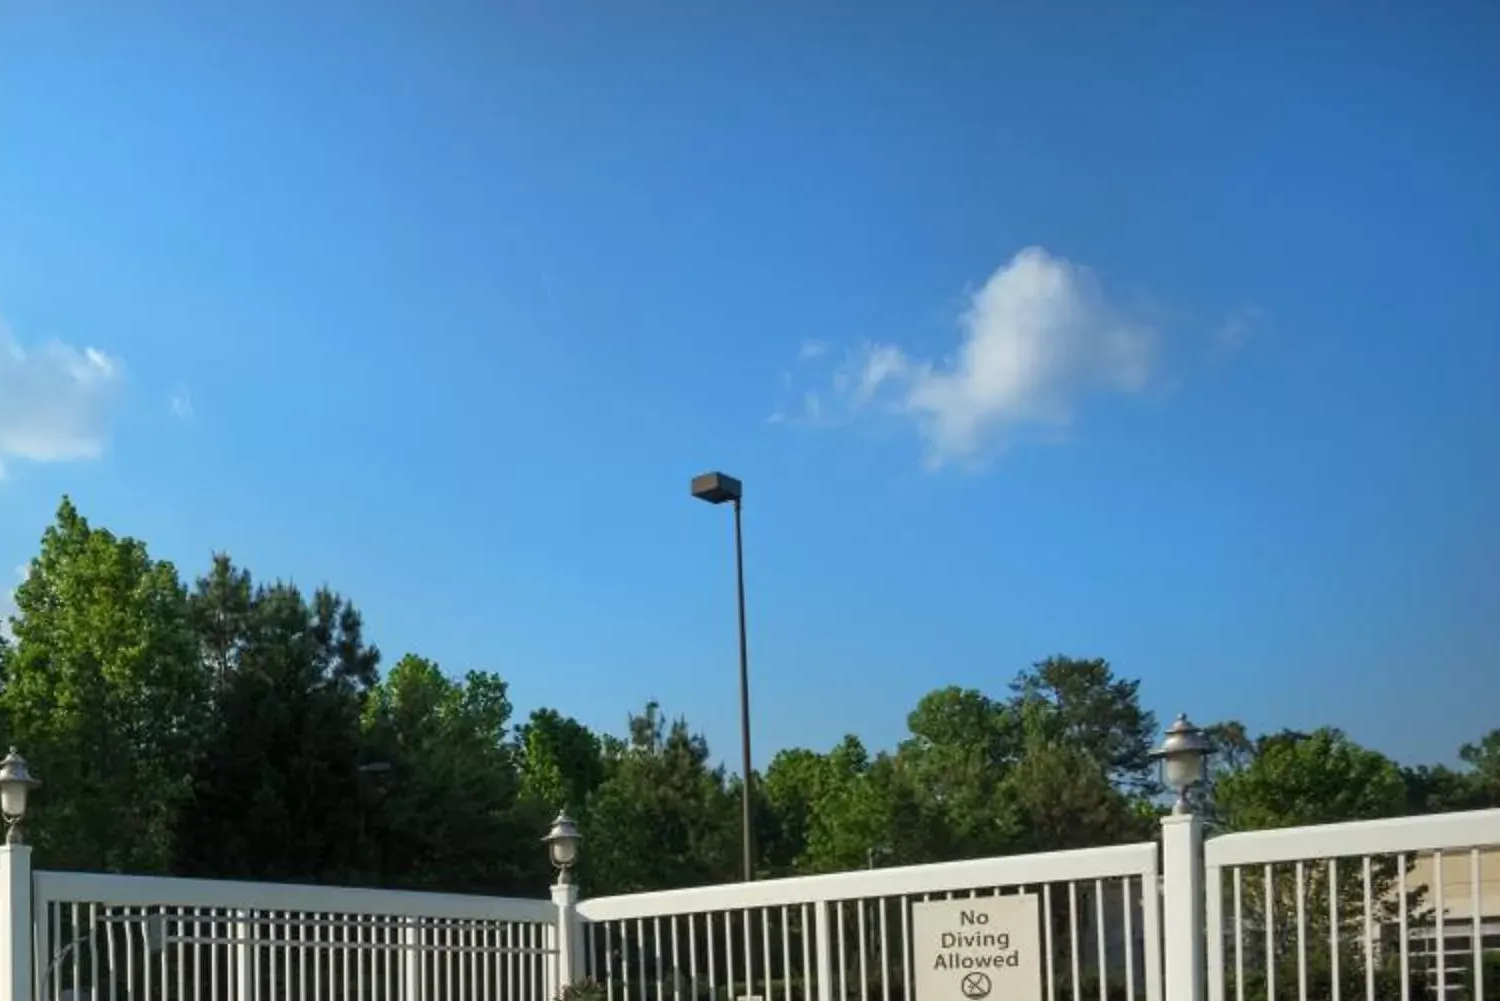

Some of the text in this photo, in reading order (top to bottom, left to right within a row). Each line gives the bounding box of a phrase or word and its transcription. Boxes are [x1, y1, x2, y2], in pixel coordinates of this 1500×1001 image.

[960, 909, 989, 926] No
[941, 931, 1009, 951] Diving
[933, 950, 1019, 970] Allowed
